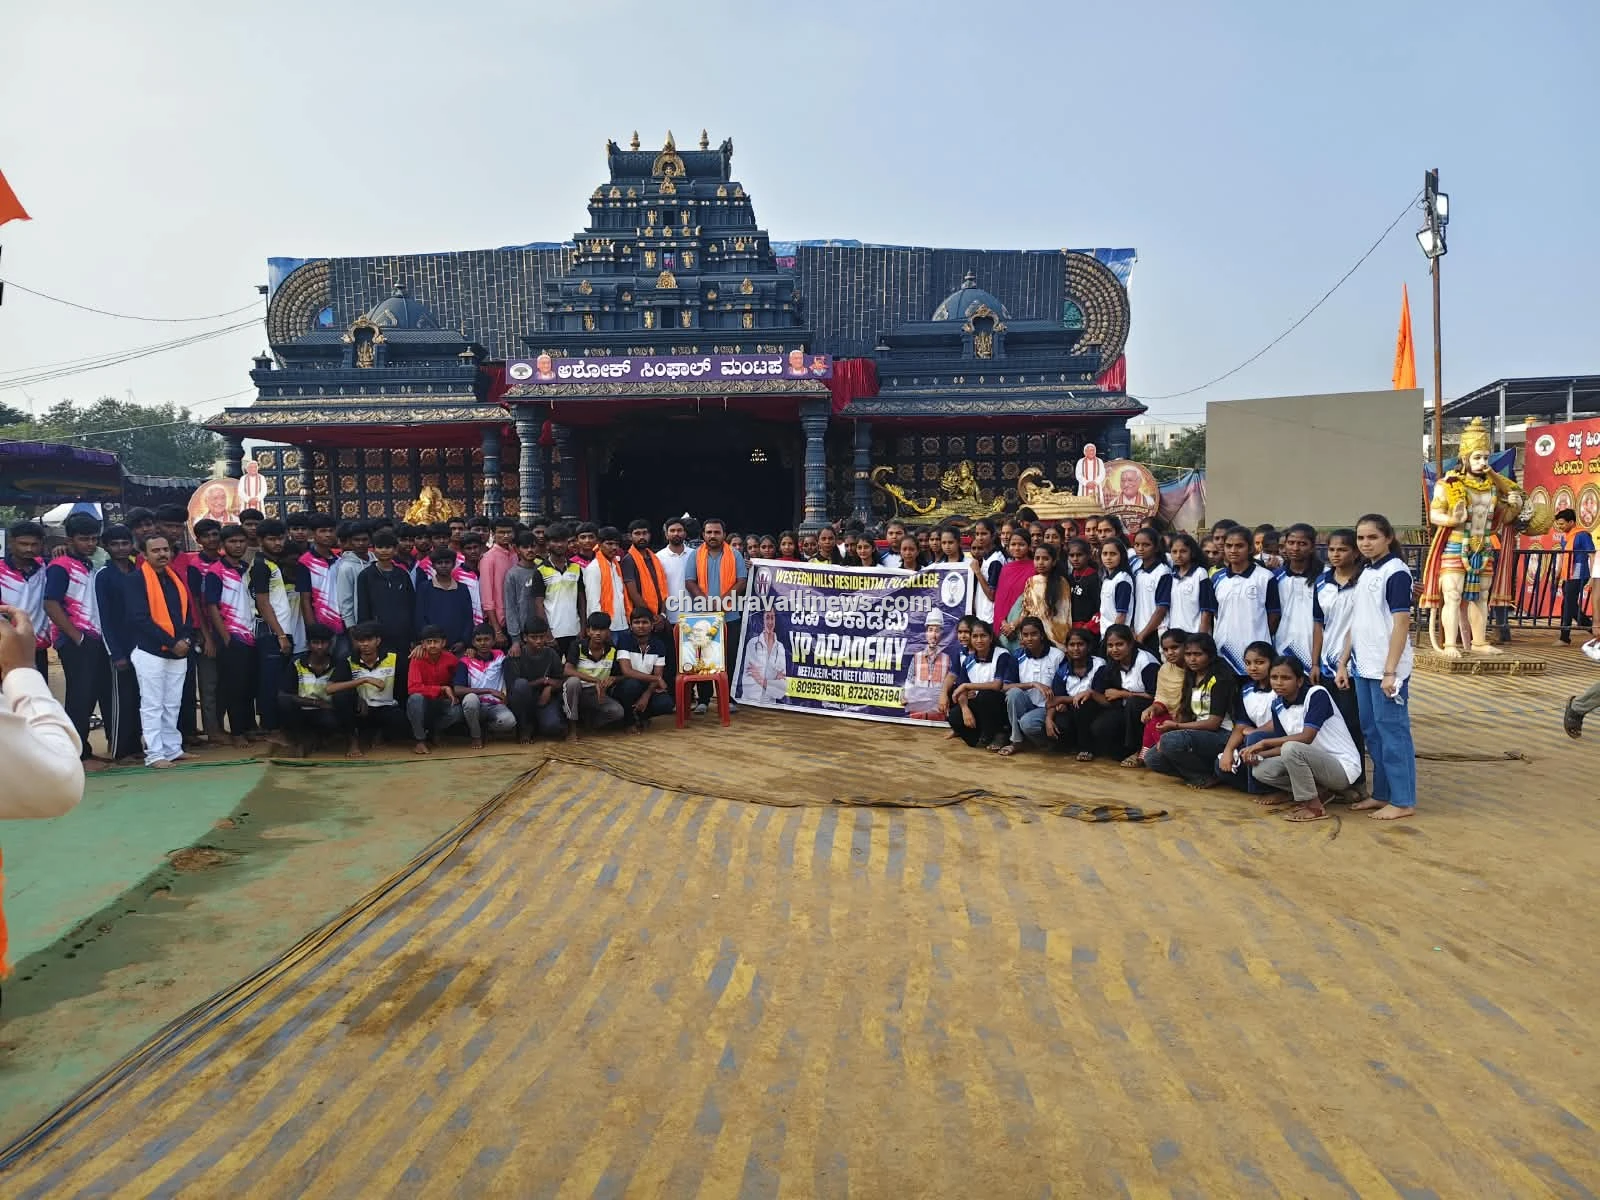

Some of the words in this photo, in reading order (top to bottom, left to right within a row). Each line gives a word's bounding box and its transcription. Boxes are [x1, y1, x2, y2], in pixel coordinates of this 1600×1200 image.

[557, 359, 632, 379] ಅಶೋಕ್
[720, 355, 783, 376] ಮಂಟಪ
[775, 569, 812, 587] WESTERN
[812, 572, 834, 589] HILLS
[834, 574, 886, 591] RESIDENTIAL
[788, 630, 813, 664] VP
[814, 633, 908, 671] ACADEMY
